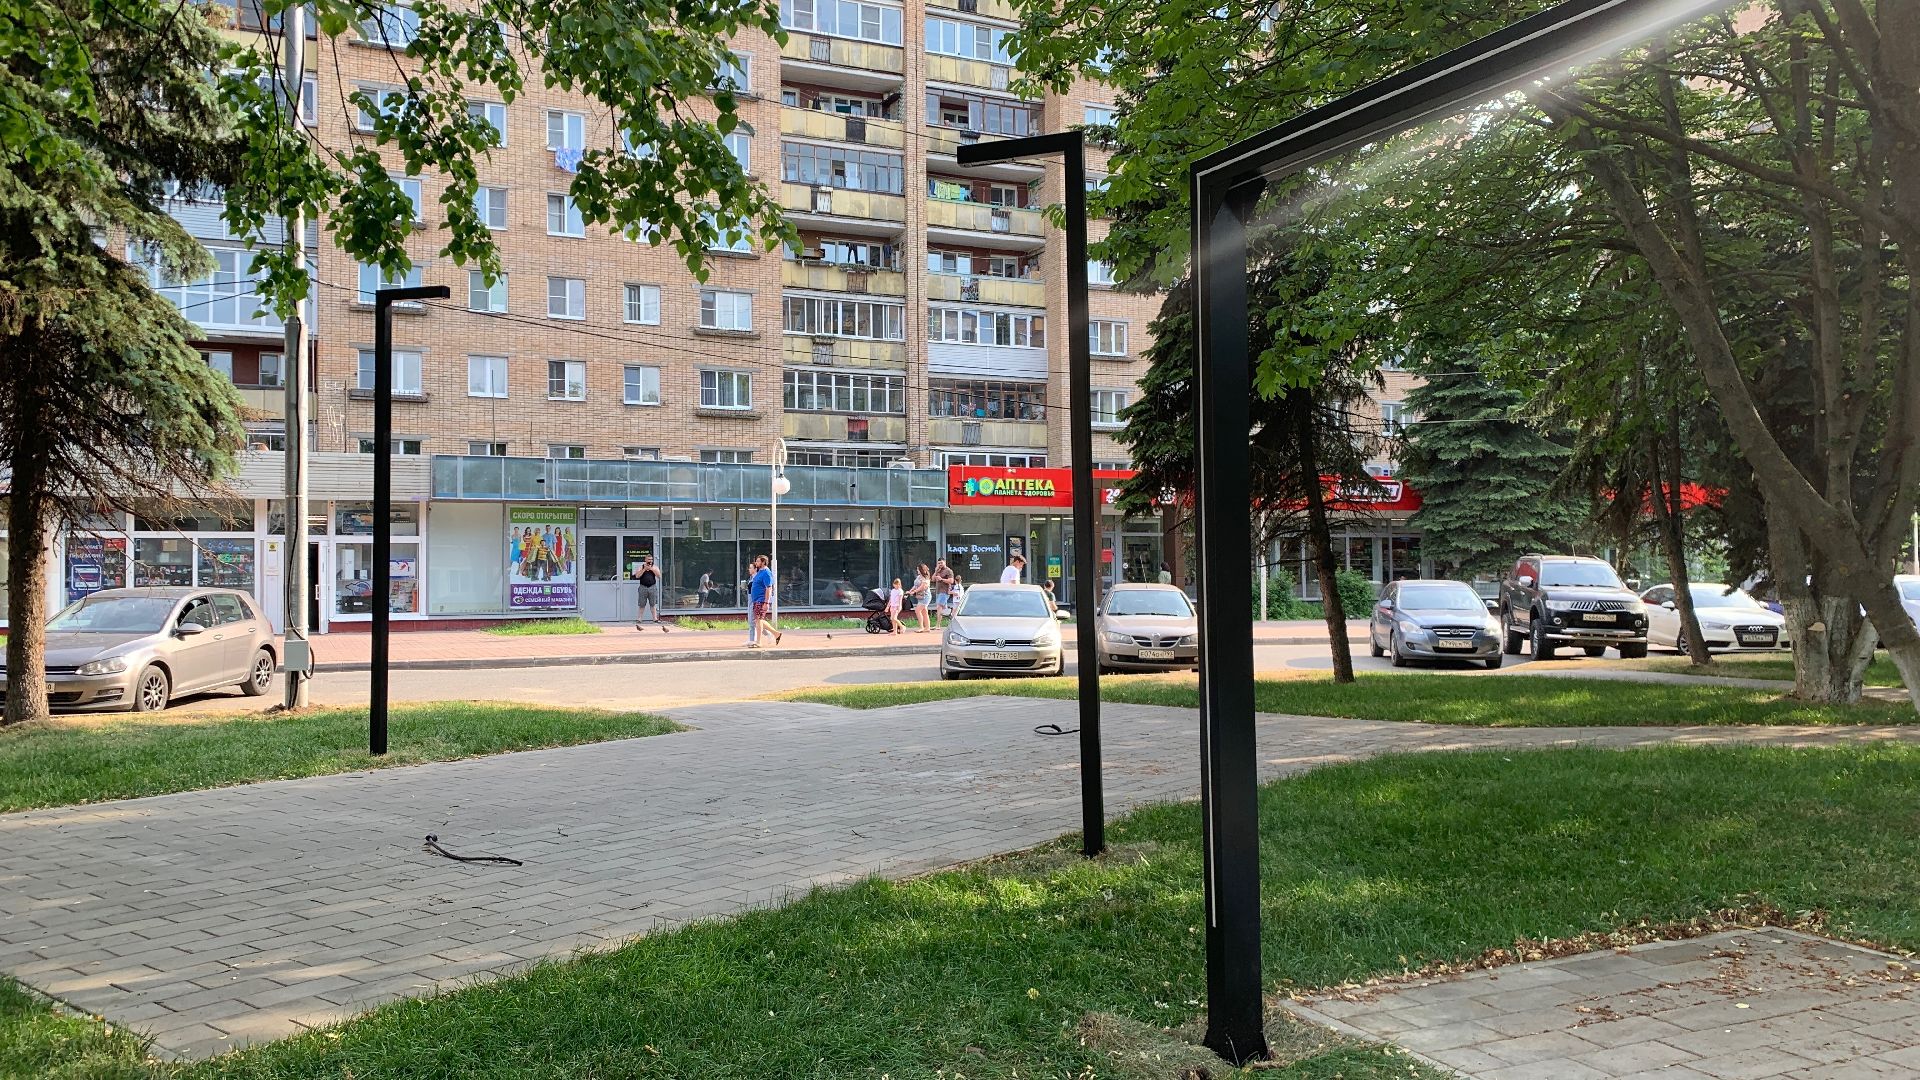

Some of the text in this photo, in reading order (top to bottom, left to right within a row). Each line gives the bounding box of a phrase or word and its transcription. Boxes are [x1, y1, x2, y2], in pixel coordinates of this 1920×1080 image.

[995, 478, 1055, 491] АПТЕКА
[512, 511, 573, 520] СКОРО ОТКРЫТИЕ!
[513, 586, 542, 595] ОДЕЖДА
[552, 586, 572, 594] ОБУВЬ
